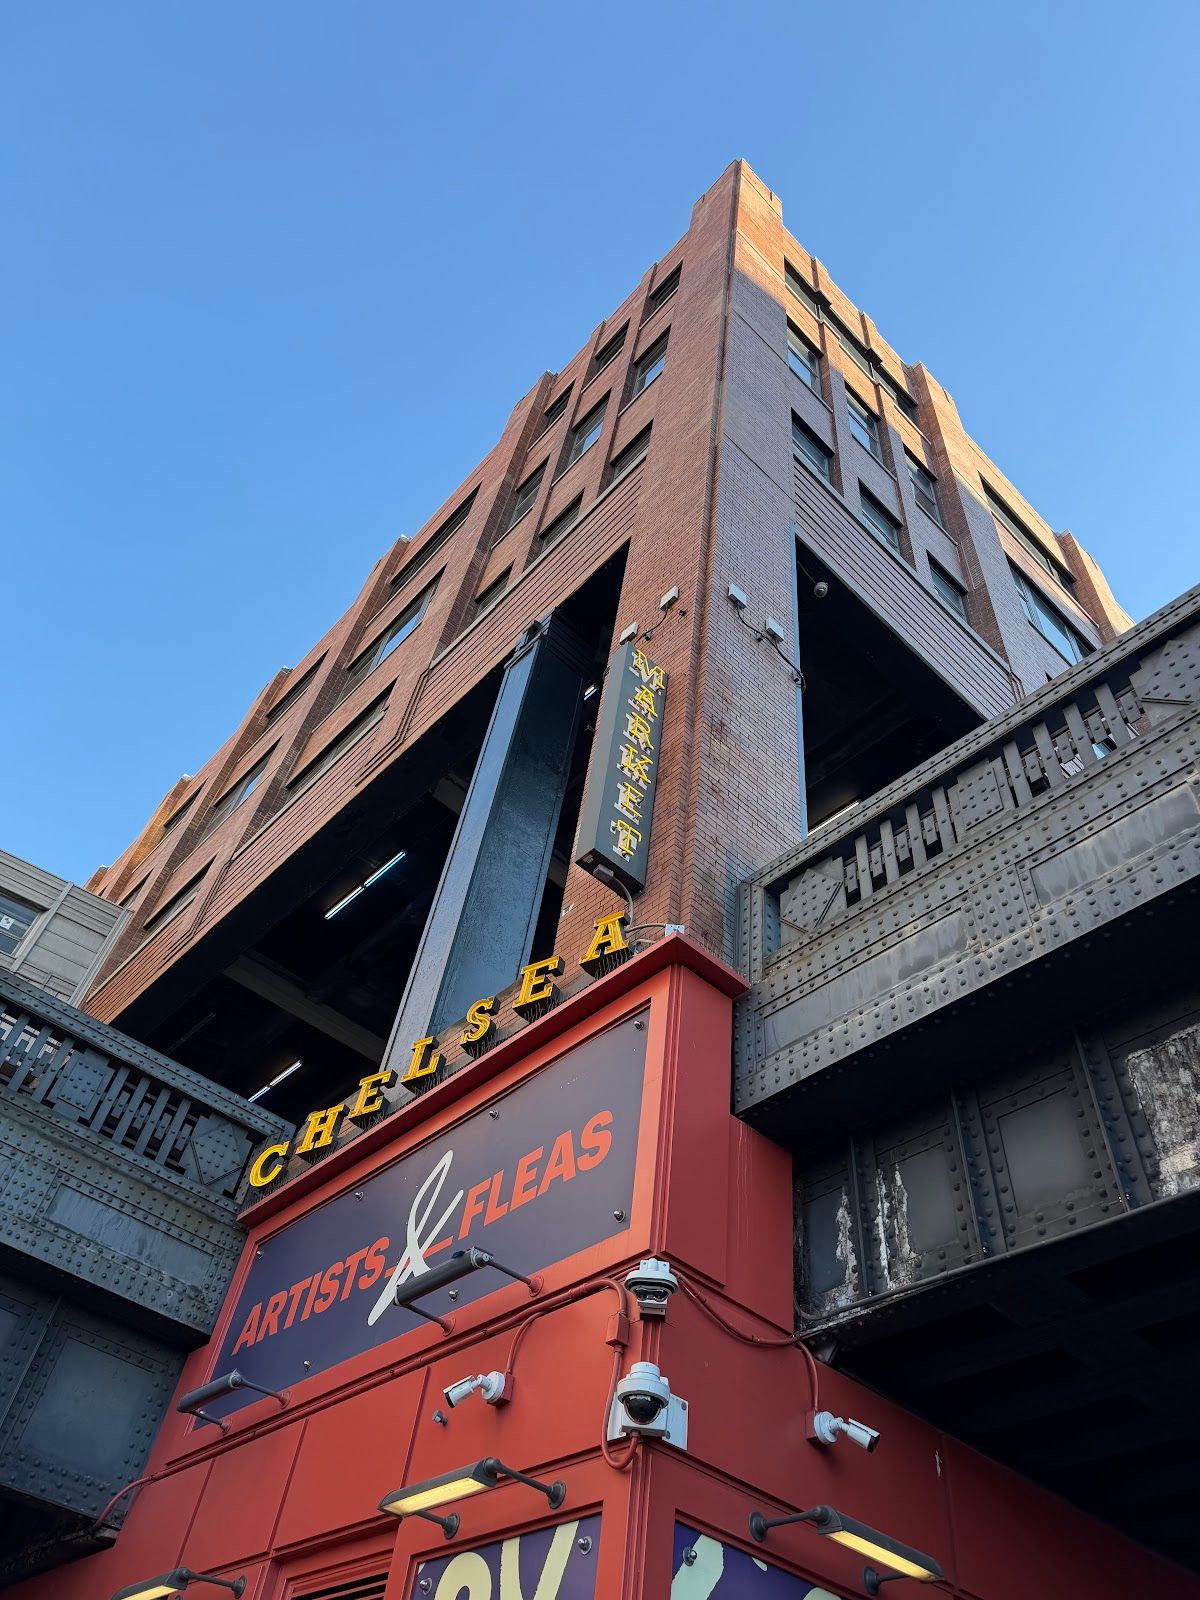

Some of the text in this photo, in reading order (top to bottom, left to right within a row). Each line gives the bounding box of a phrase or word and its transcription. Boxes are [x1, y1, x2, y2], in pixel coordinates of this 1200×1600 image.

[610, 649, 666, 862] MARKET
[249, 910, 630, 1188] CHELSEA
[231, 1109, 613, 1356] ARTISTS & FLEAS
